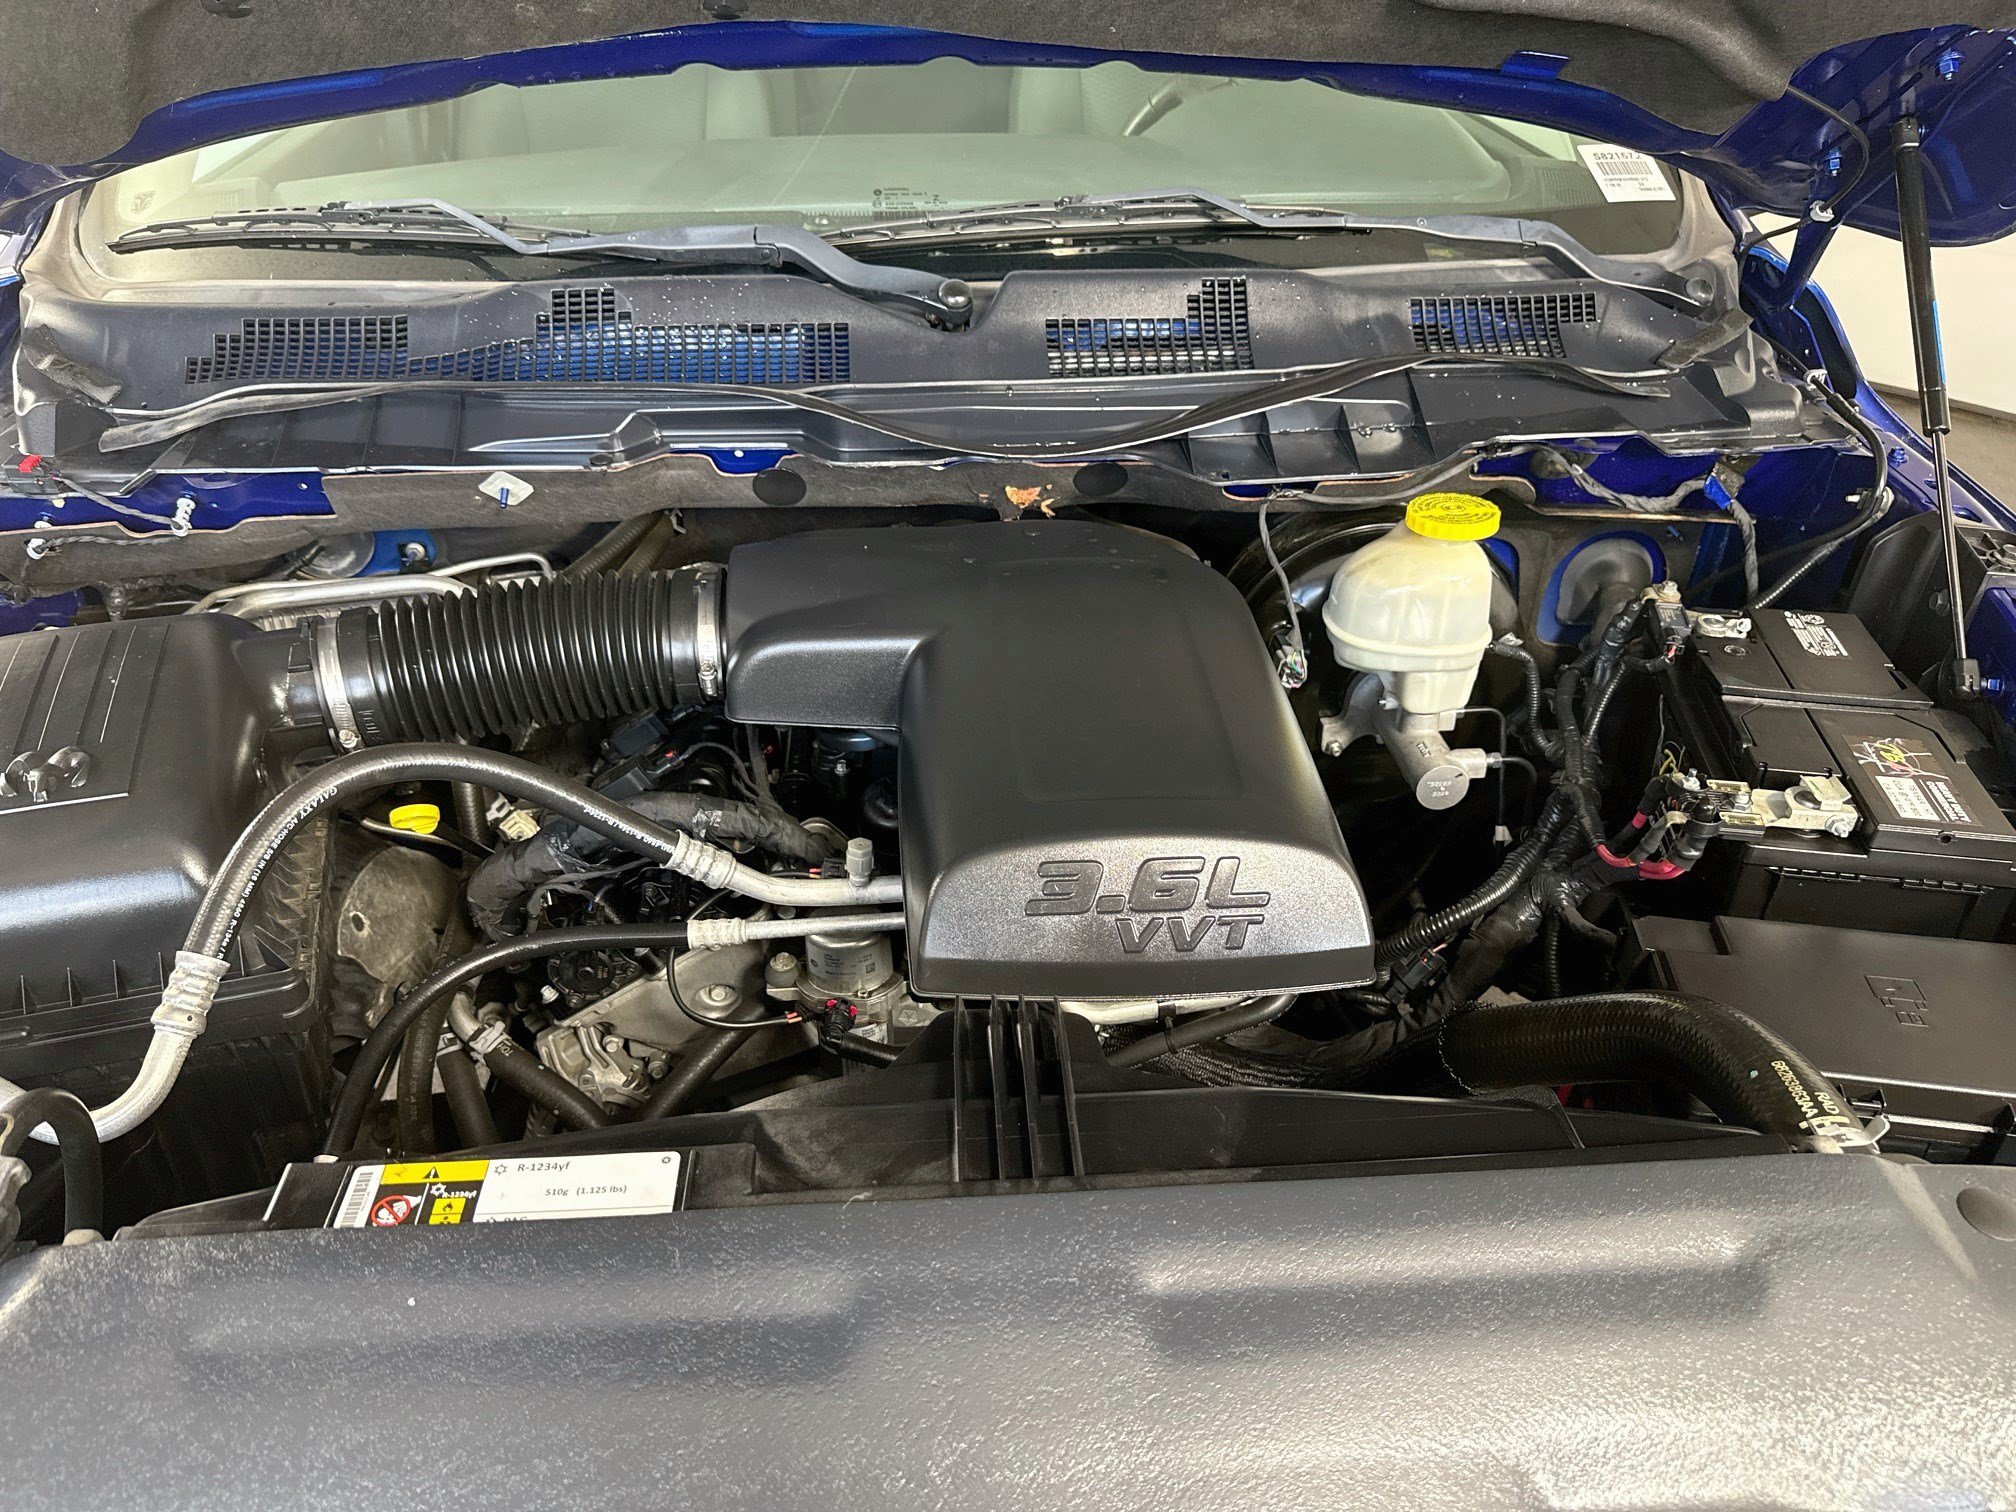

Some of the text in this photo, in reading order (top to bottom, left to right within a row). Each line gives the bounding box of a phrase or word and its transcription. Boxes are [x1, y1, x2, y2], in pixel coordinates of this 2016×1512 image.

[299, 786, 338, 820] GALAXY
[263, 848, 274, 860] 5/8
[257, 859, 267, 869] IN
[241, 880, 255, 897] MM)
[1024, 855, 1271, 916] 3.6L
[1115, 914, 1266, 953] VVT
[1814, 1091, 1840, 1115] RAD
[517, 1161, 571, 1172] R-1234yf
[545, 1184, 628, 1197] 510g (1.125 lbs)
